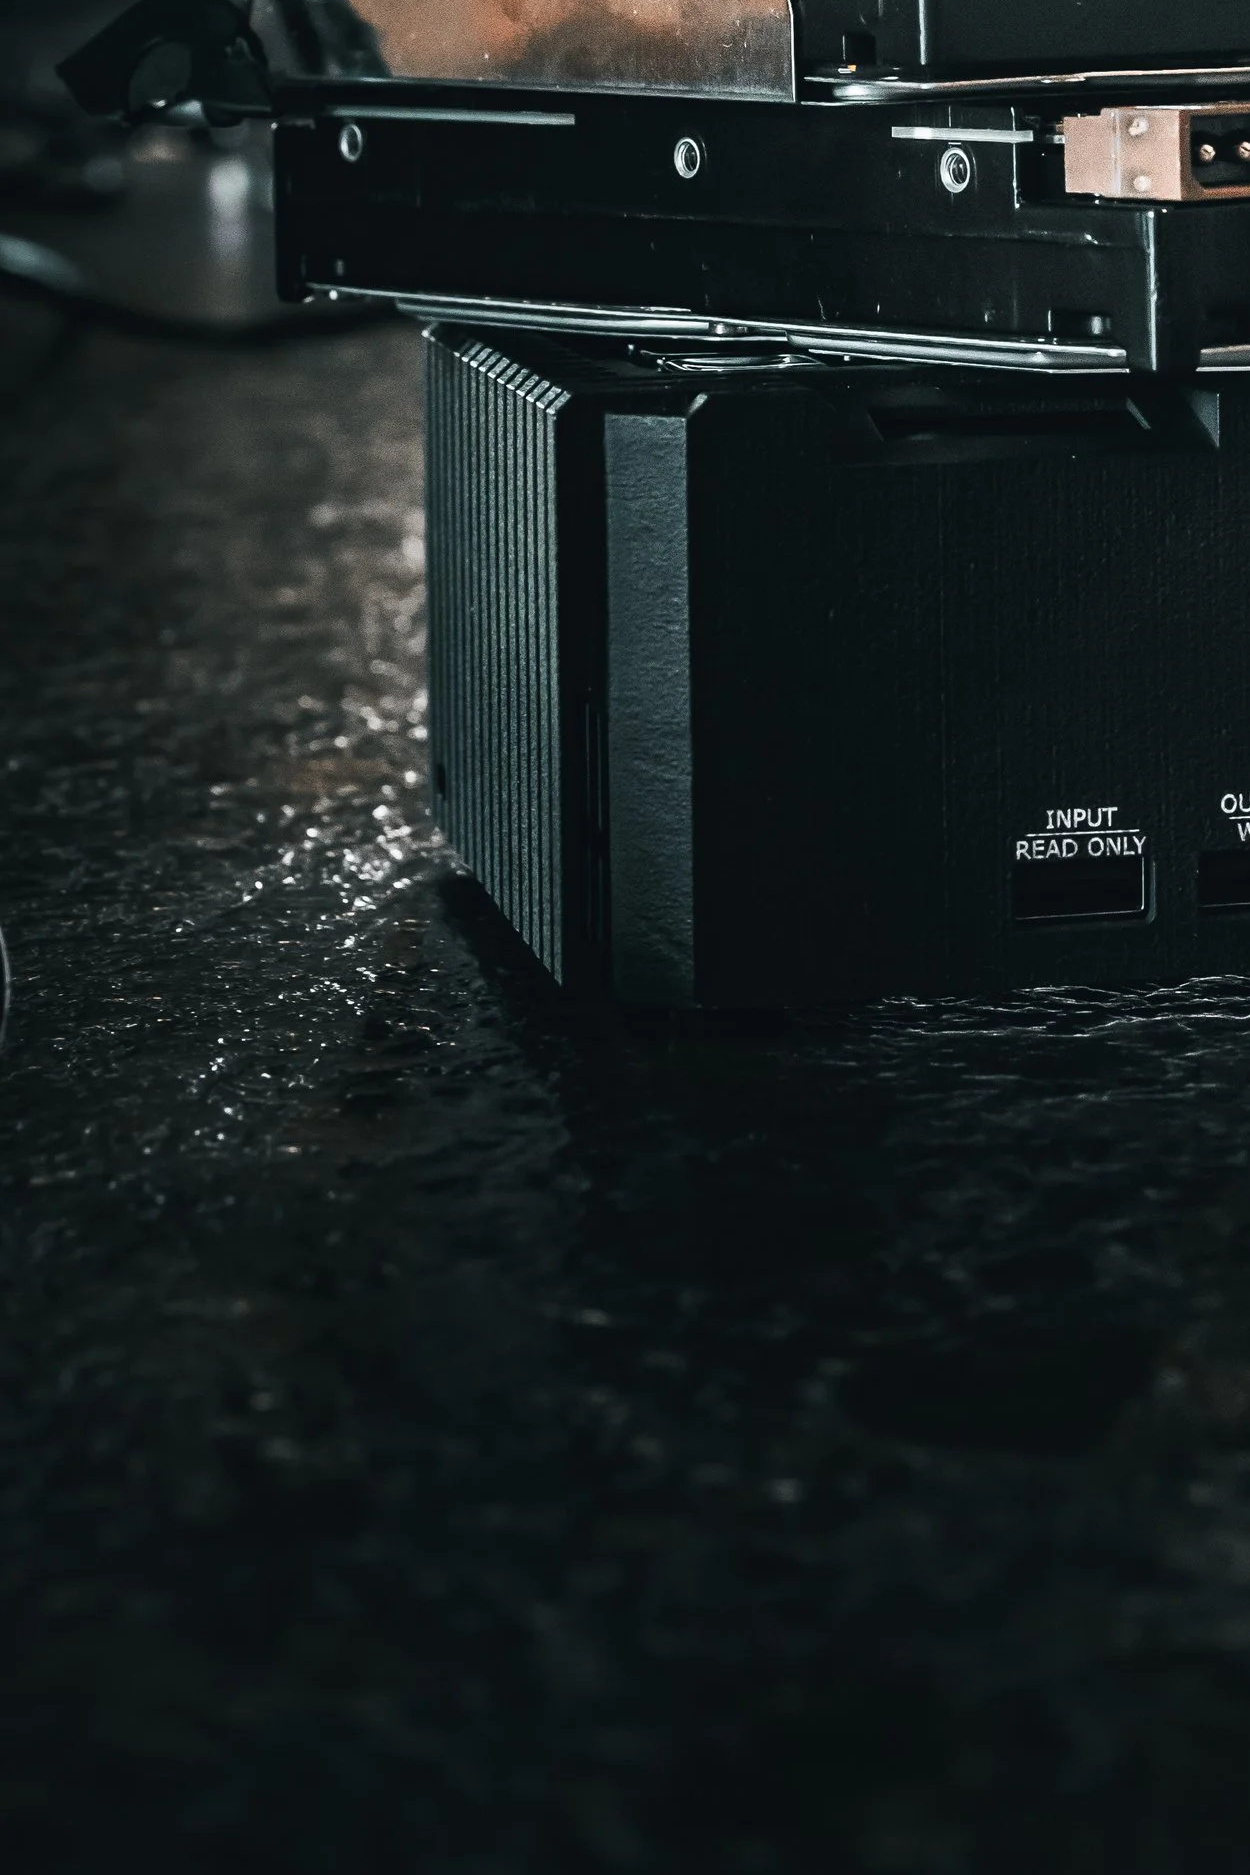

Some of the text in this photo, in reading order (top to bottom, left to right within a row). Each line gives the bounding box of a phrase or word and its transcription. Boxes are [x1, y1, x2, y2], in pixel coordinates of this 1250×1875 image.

[1046, 806, 1119, 830] INPUT
[1015, 835, 1147, 861] READ ONLY
